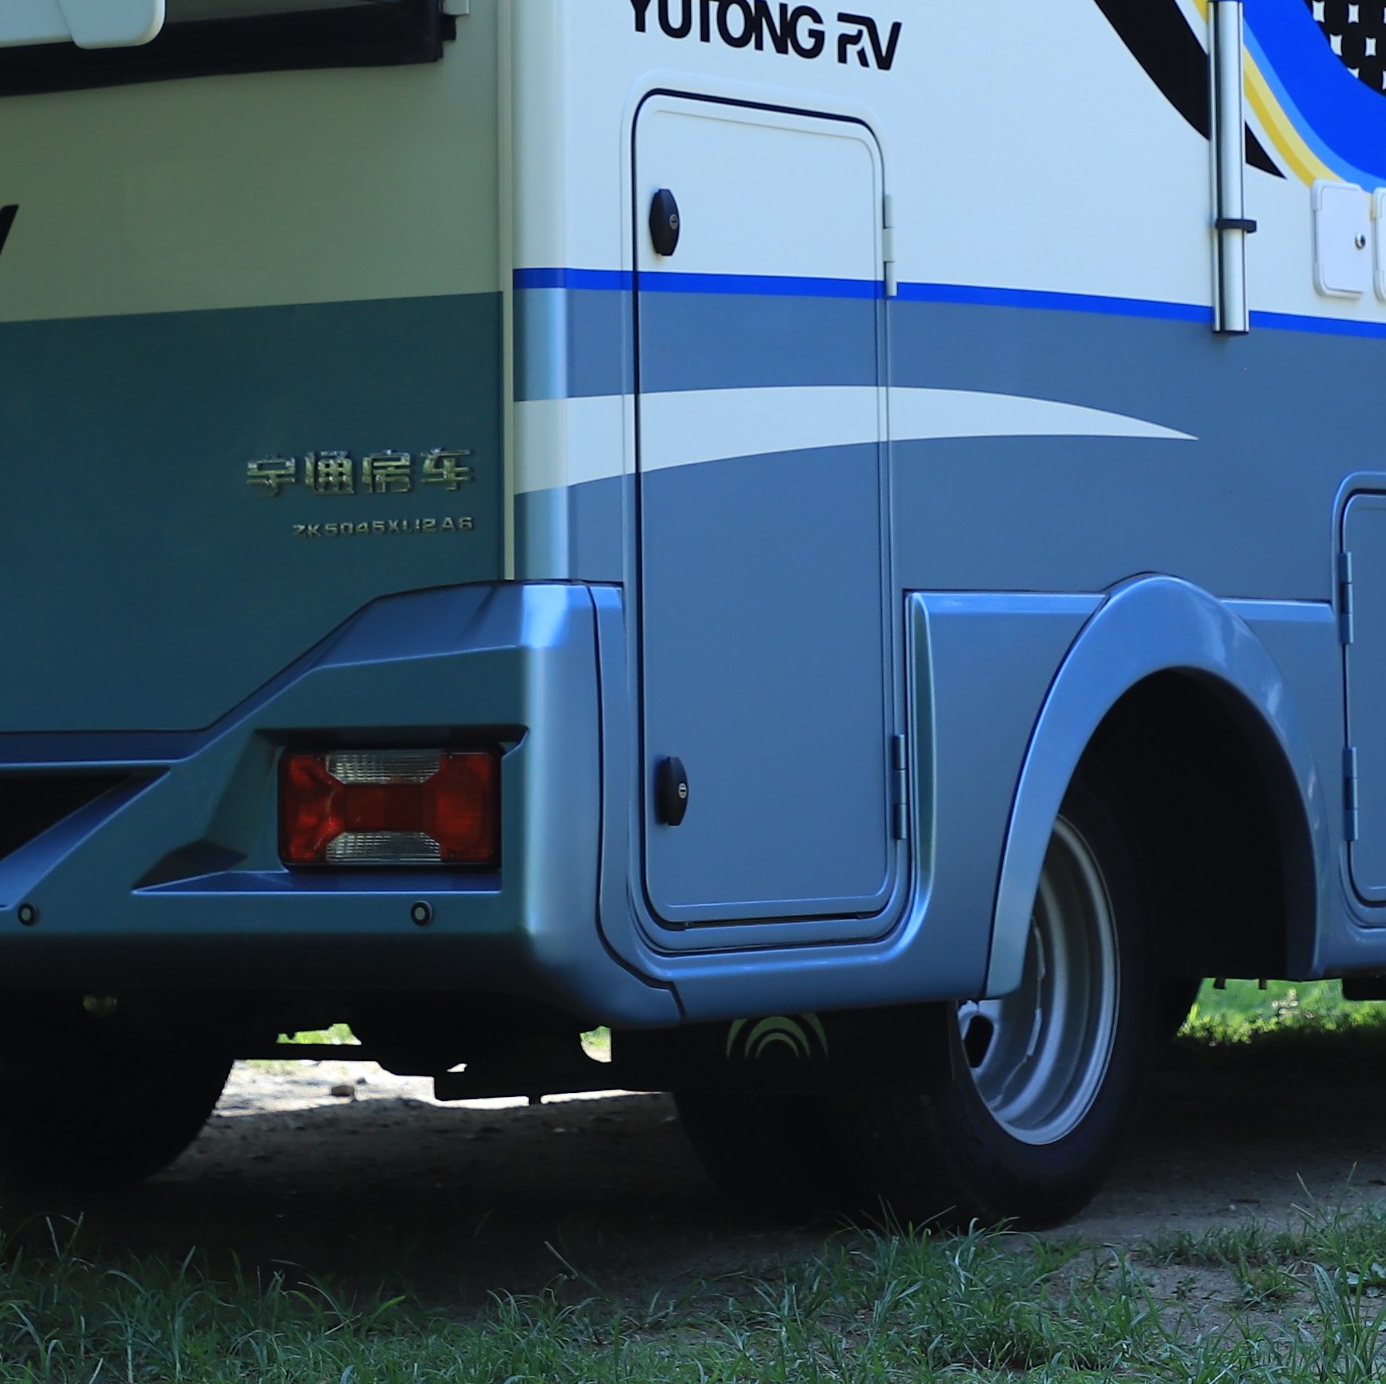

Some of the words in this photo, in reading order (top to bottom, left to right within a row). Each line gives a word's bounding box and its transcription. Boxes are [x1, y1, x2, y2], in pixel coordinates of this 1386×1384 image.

[836, 11, 903, 71] RV
[246, 447, 473, 498] 宇通房车
